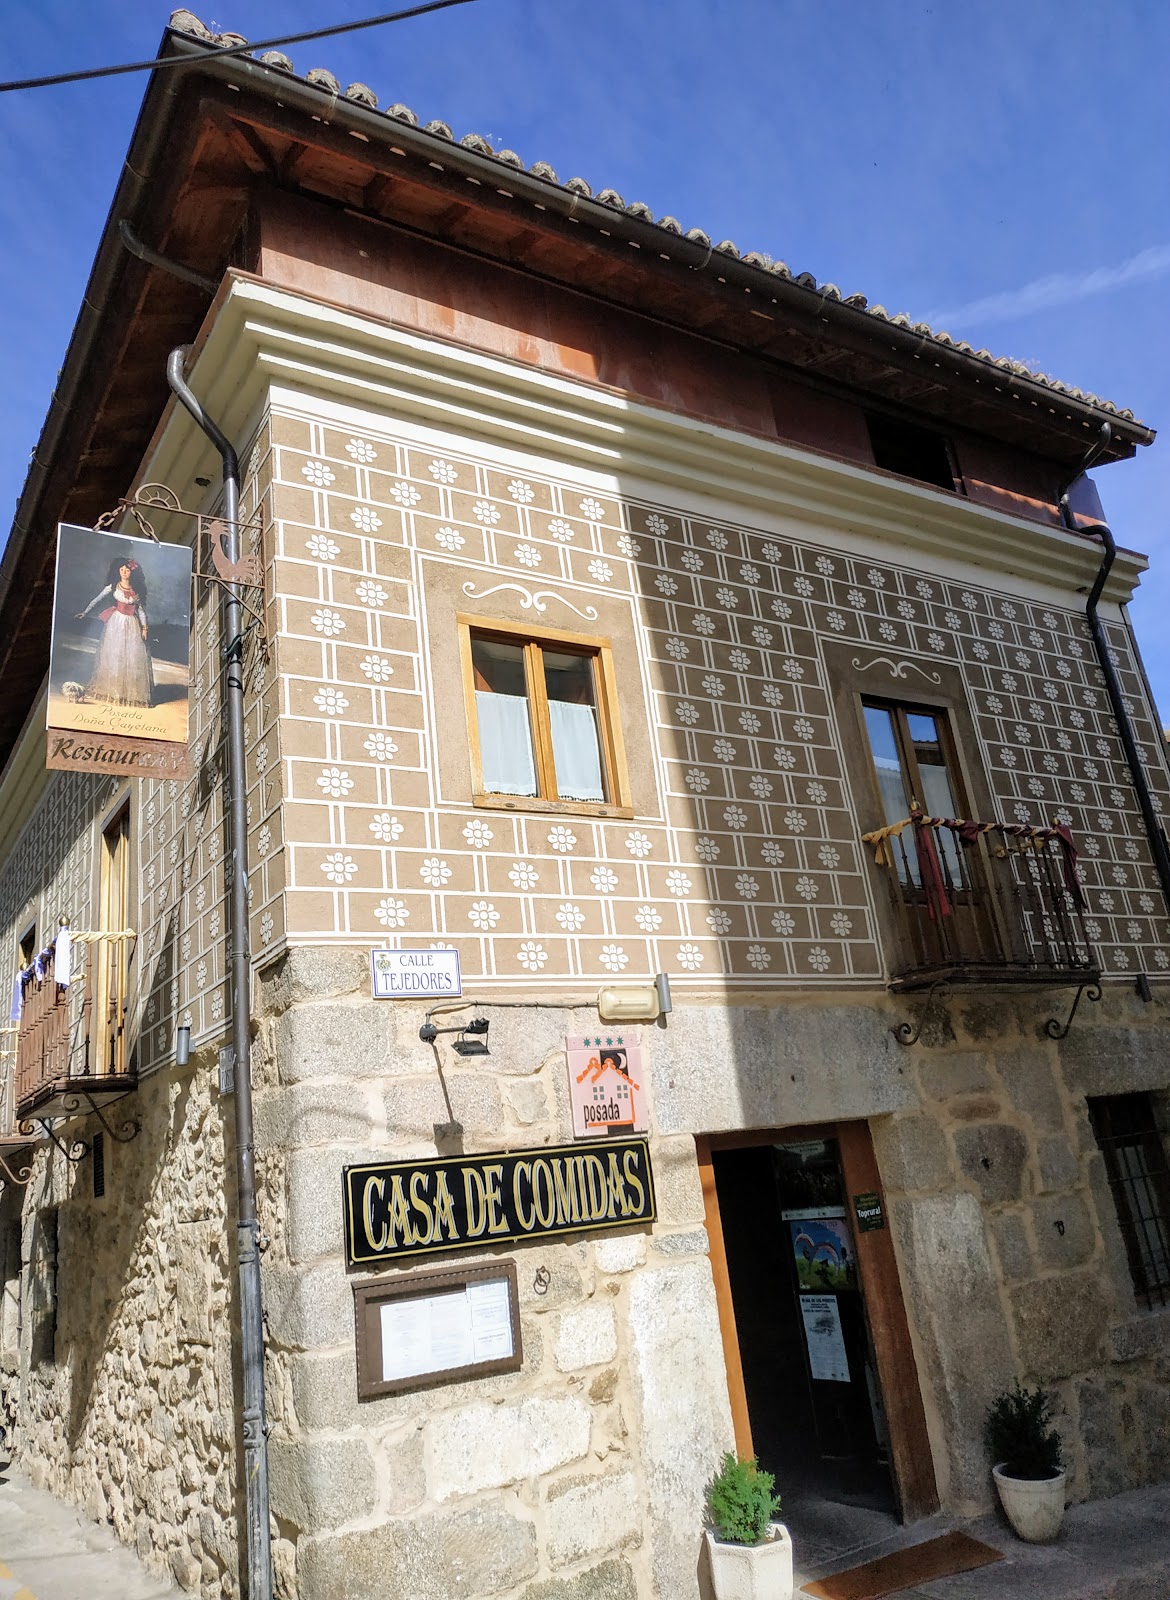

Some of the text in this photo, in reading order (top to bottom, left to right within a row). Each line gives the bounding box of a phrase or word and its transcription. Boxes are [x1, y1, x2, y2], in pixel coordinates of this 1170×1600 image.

[98, 704, 144, 720] Posada
[73, 713, 167, 733] Doña Cayetana
[399, 955, 434, 967] CALLE
[382, 972, 452, 990] TEJEDORES
[583, 1097, 620, 1129] posada
[362, 1149, 645, 1251] CASA DE COMIDAS
[857, 1206, 881, 1219] Toprural
